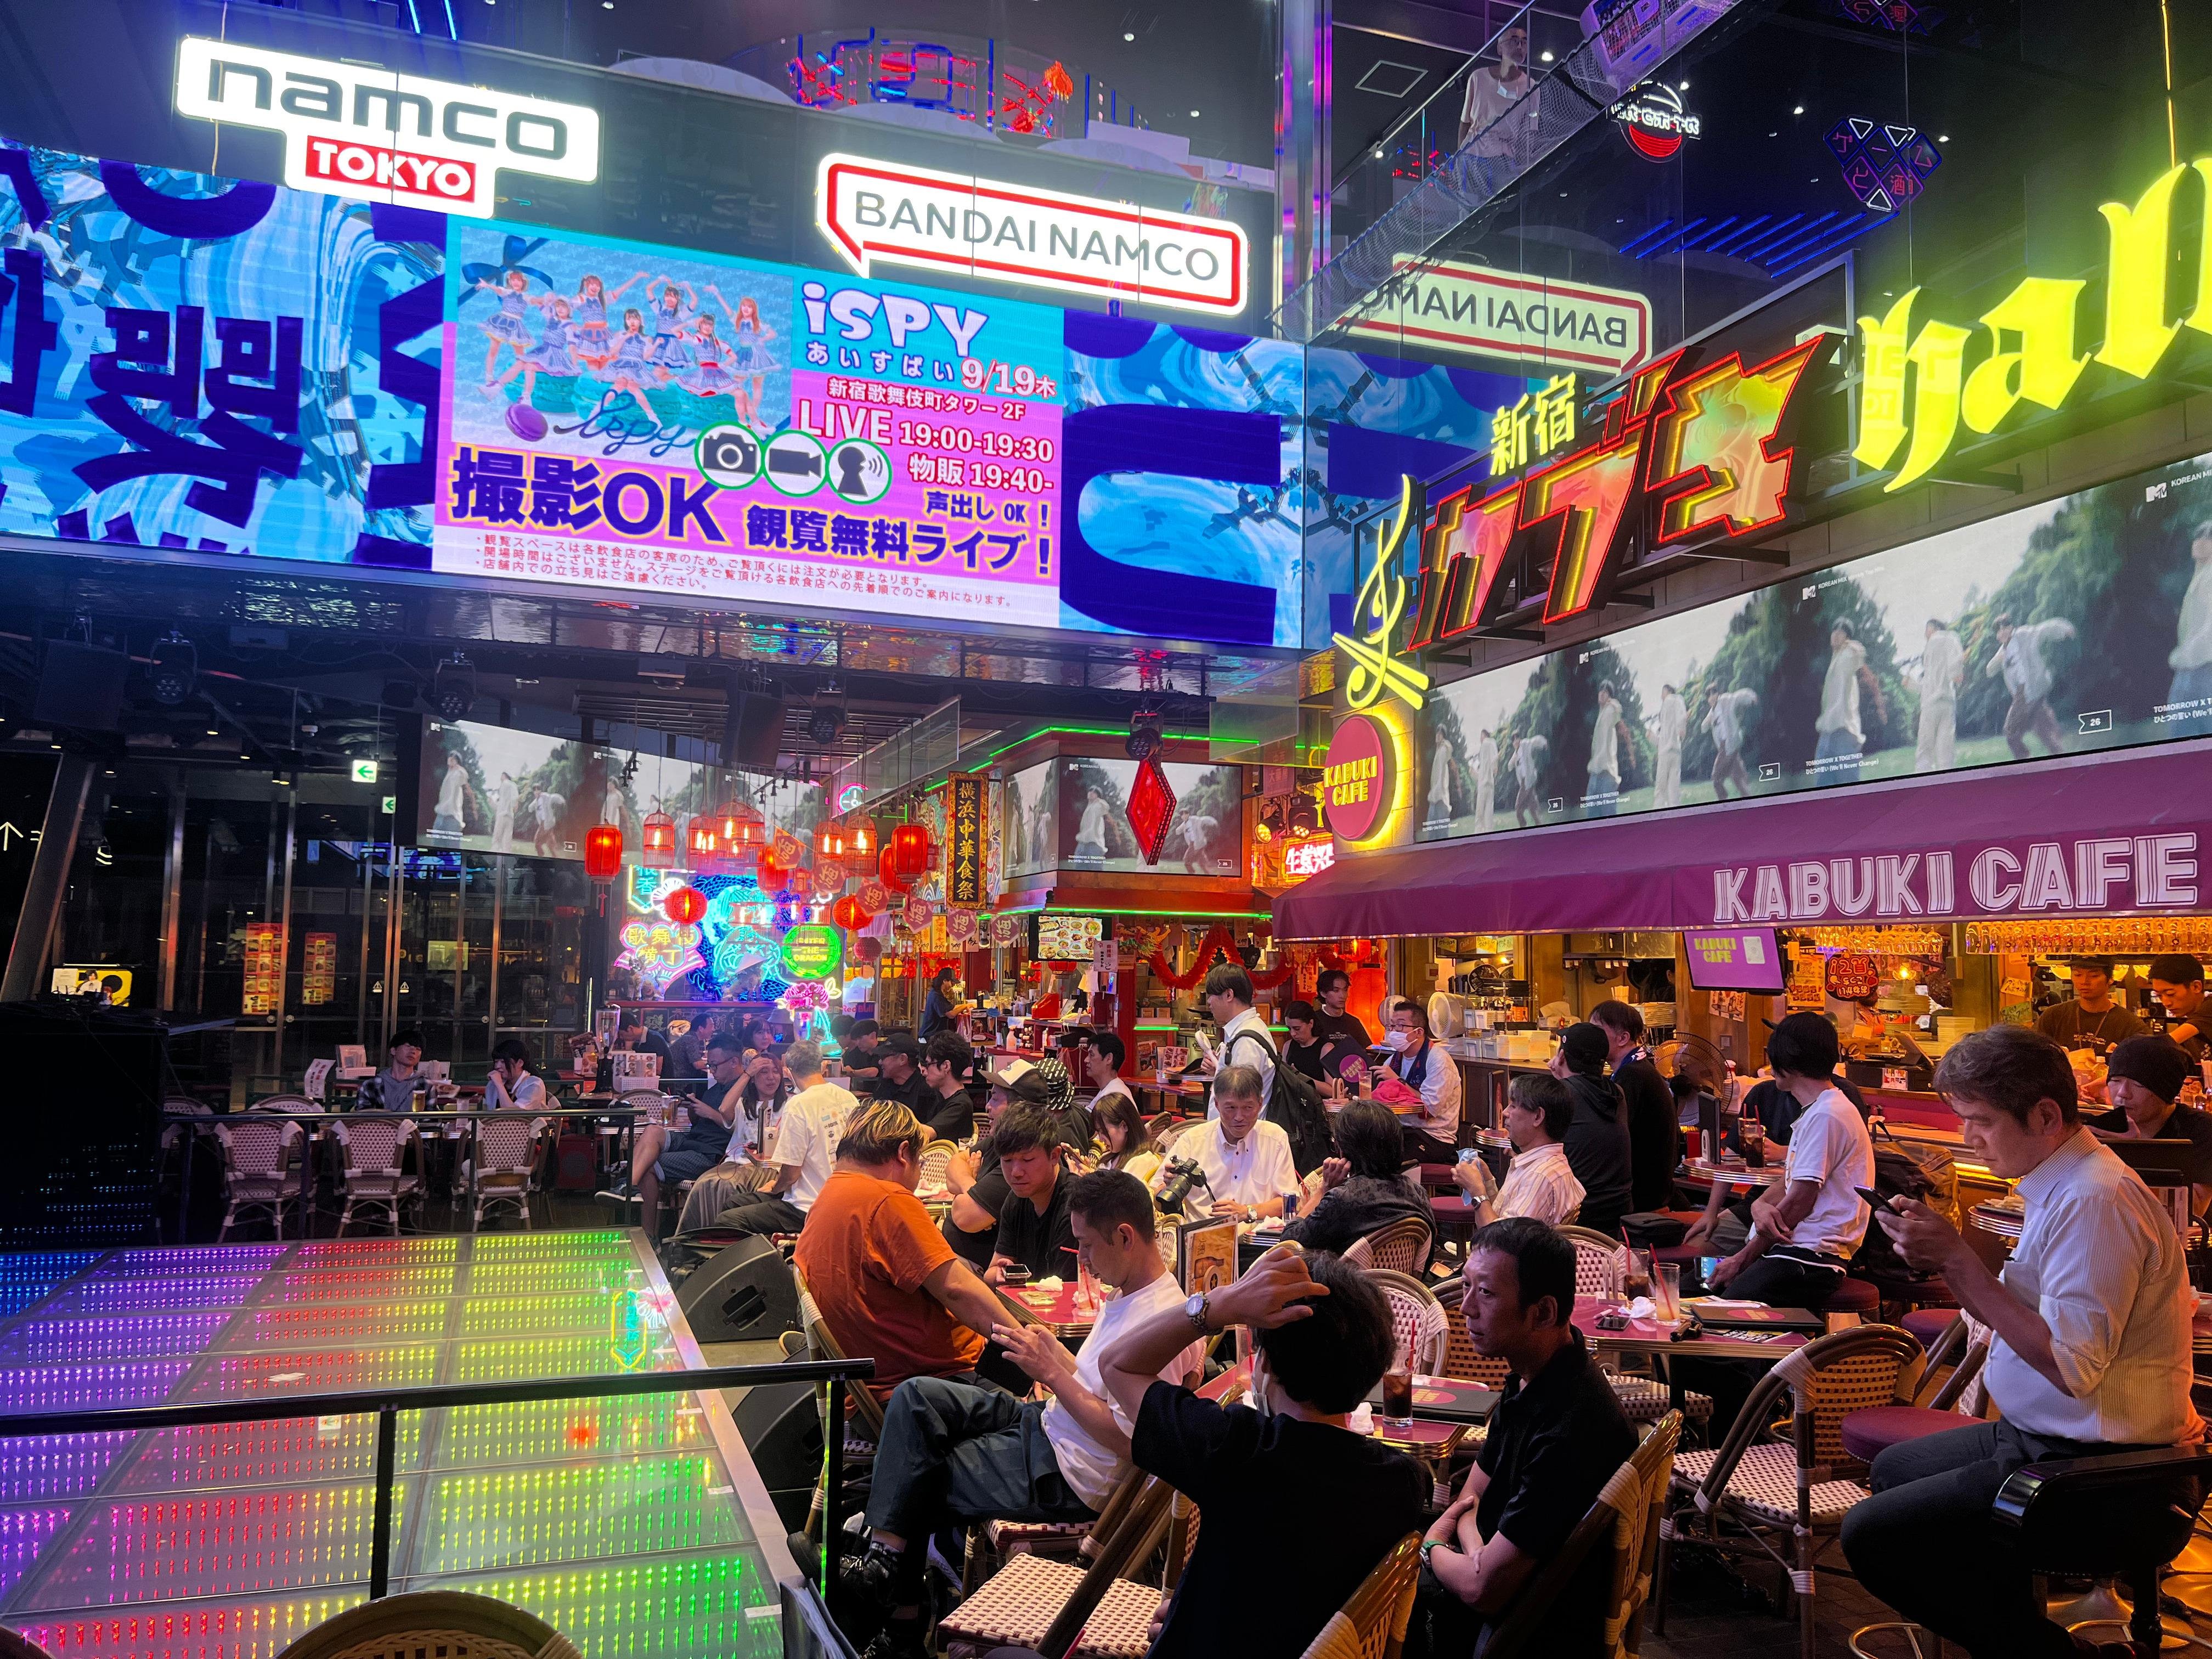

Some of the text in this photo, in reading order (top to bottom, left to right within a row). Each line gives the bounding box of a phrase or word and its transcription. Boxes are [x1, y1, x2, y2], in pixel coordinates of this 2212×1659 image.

[208, 59, 567, 161] namco
[313, 142, 472, 197] TOKYO
[855, 190, 1220, 281] BANDAI NAMCO
[802, 281, 989, 358] iSPY
[806, 340, 955, 382] あいすぱい
[827, 376, 1026, 422] 新宿歌舞伎町タワー 2F
[799, 398, 1054, 462] LIVE 19:00-19:30
[1489, 371, 1577, 477] 新宿
[448, 442, 734, 546] 撮影OK
[907, 452, 1054, 494] 物販 19:40-
[2171, 472, 2202, 487] KOREAN
[925, 489, 997, 522] 声出し
[2090, 718, 2101, 727] 26
[2154, 699, 2198, 713] TOMORROW
[1323, 755, 1378, 788] KABUKI
[1805, 758, 1833, 767] TOMORROW
[1839, 753, 1863, 761] TOGETHER
[1331, 780, 1369, 807] CAFE
[956, 781, 977, 900] 横浜中華食祭
[1713, 832, 2198, 923] KABUKI CAFE
[1694, 938, 1737, 950] KABUKI
[1703, 951, 1733, 963] CAFE
[842, 1005, 857, 1013] Red
